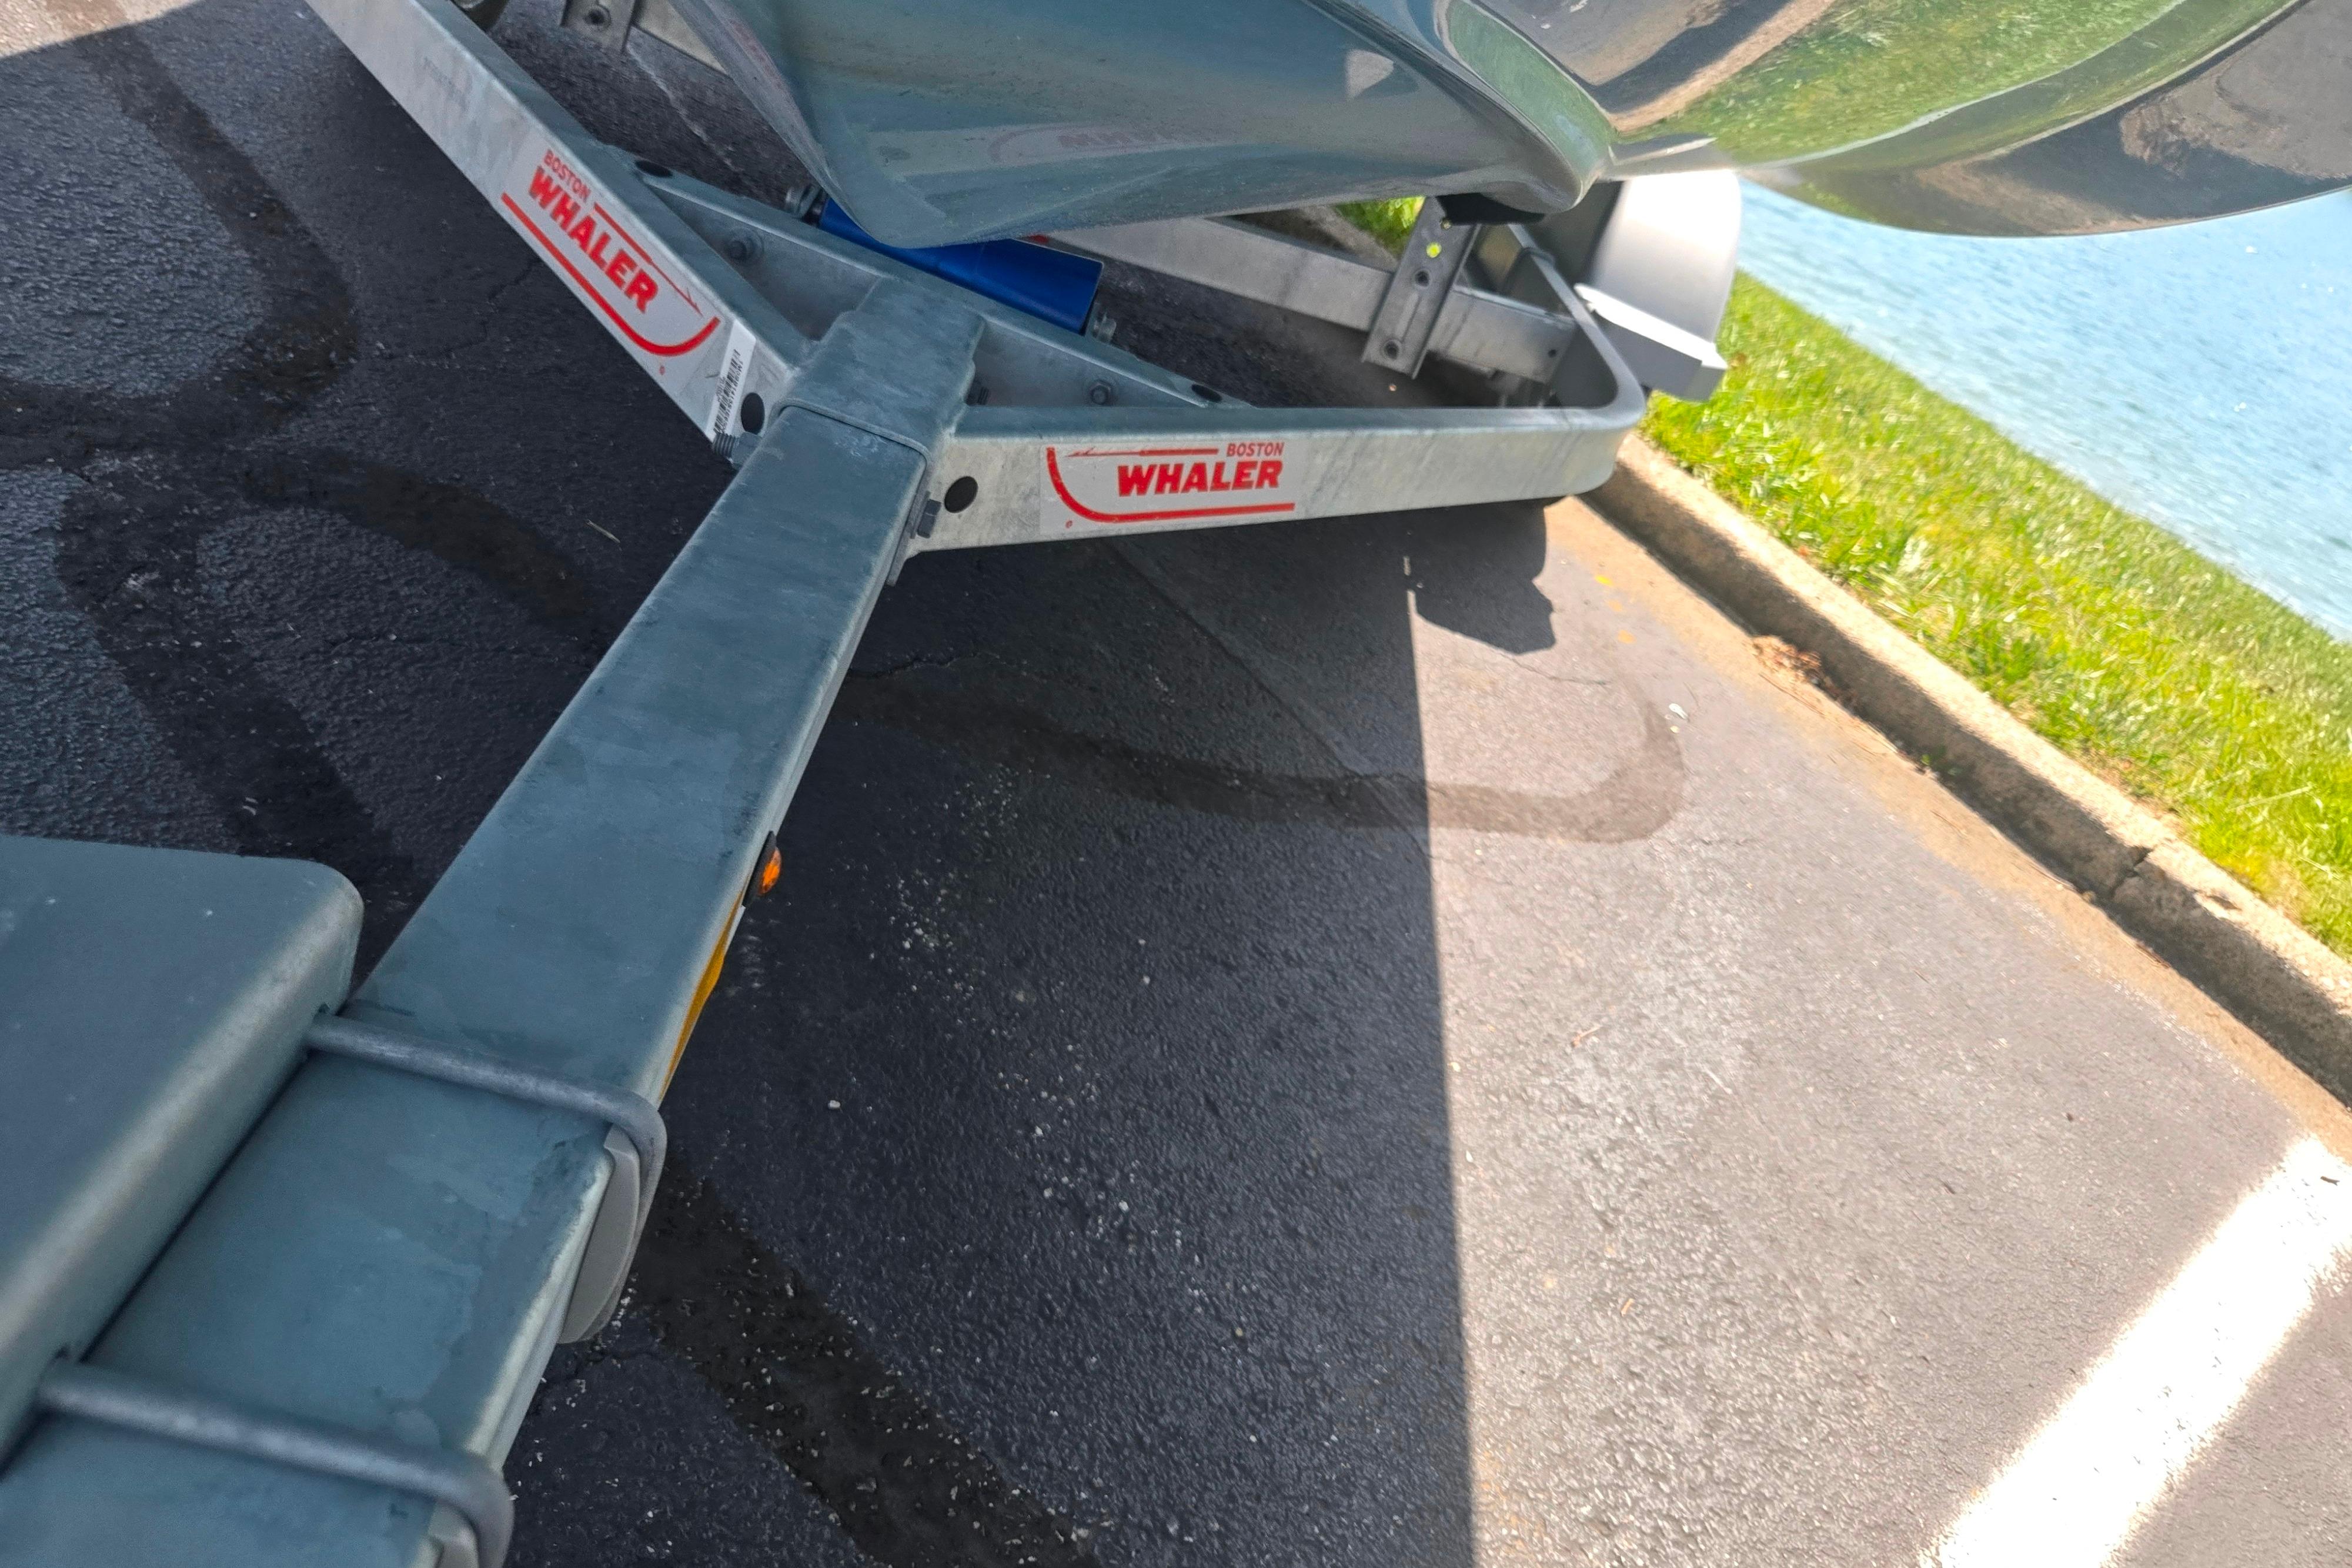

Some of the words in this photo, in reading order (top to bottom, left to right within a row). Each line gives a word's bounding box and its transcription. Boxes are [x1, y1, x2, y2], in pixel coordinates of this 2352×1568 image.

[543, 149, 592, 203] BOSTON
[529, 165, 658, 314] WHALER
[1227, 442, 1285, 457] BOSTON
[1118, 460, 1283, 497] WHALER
